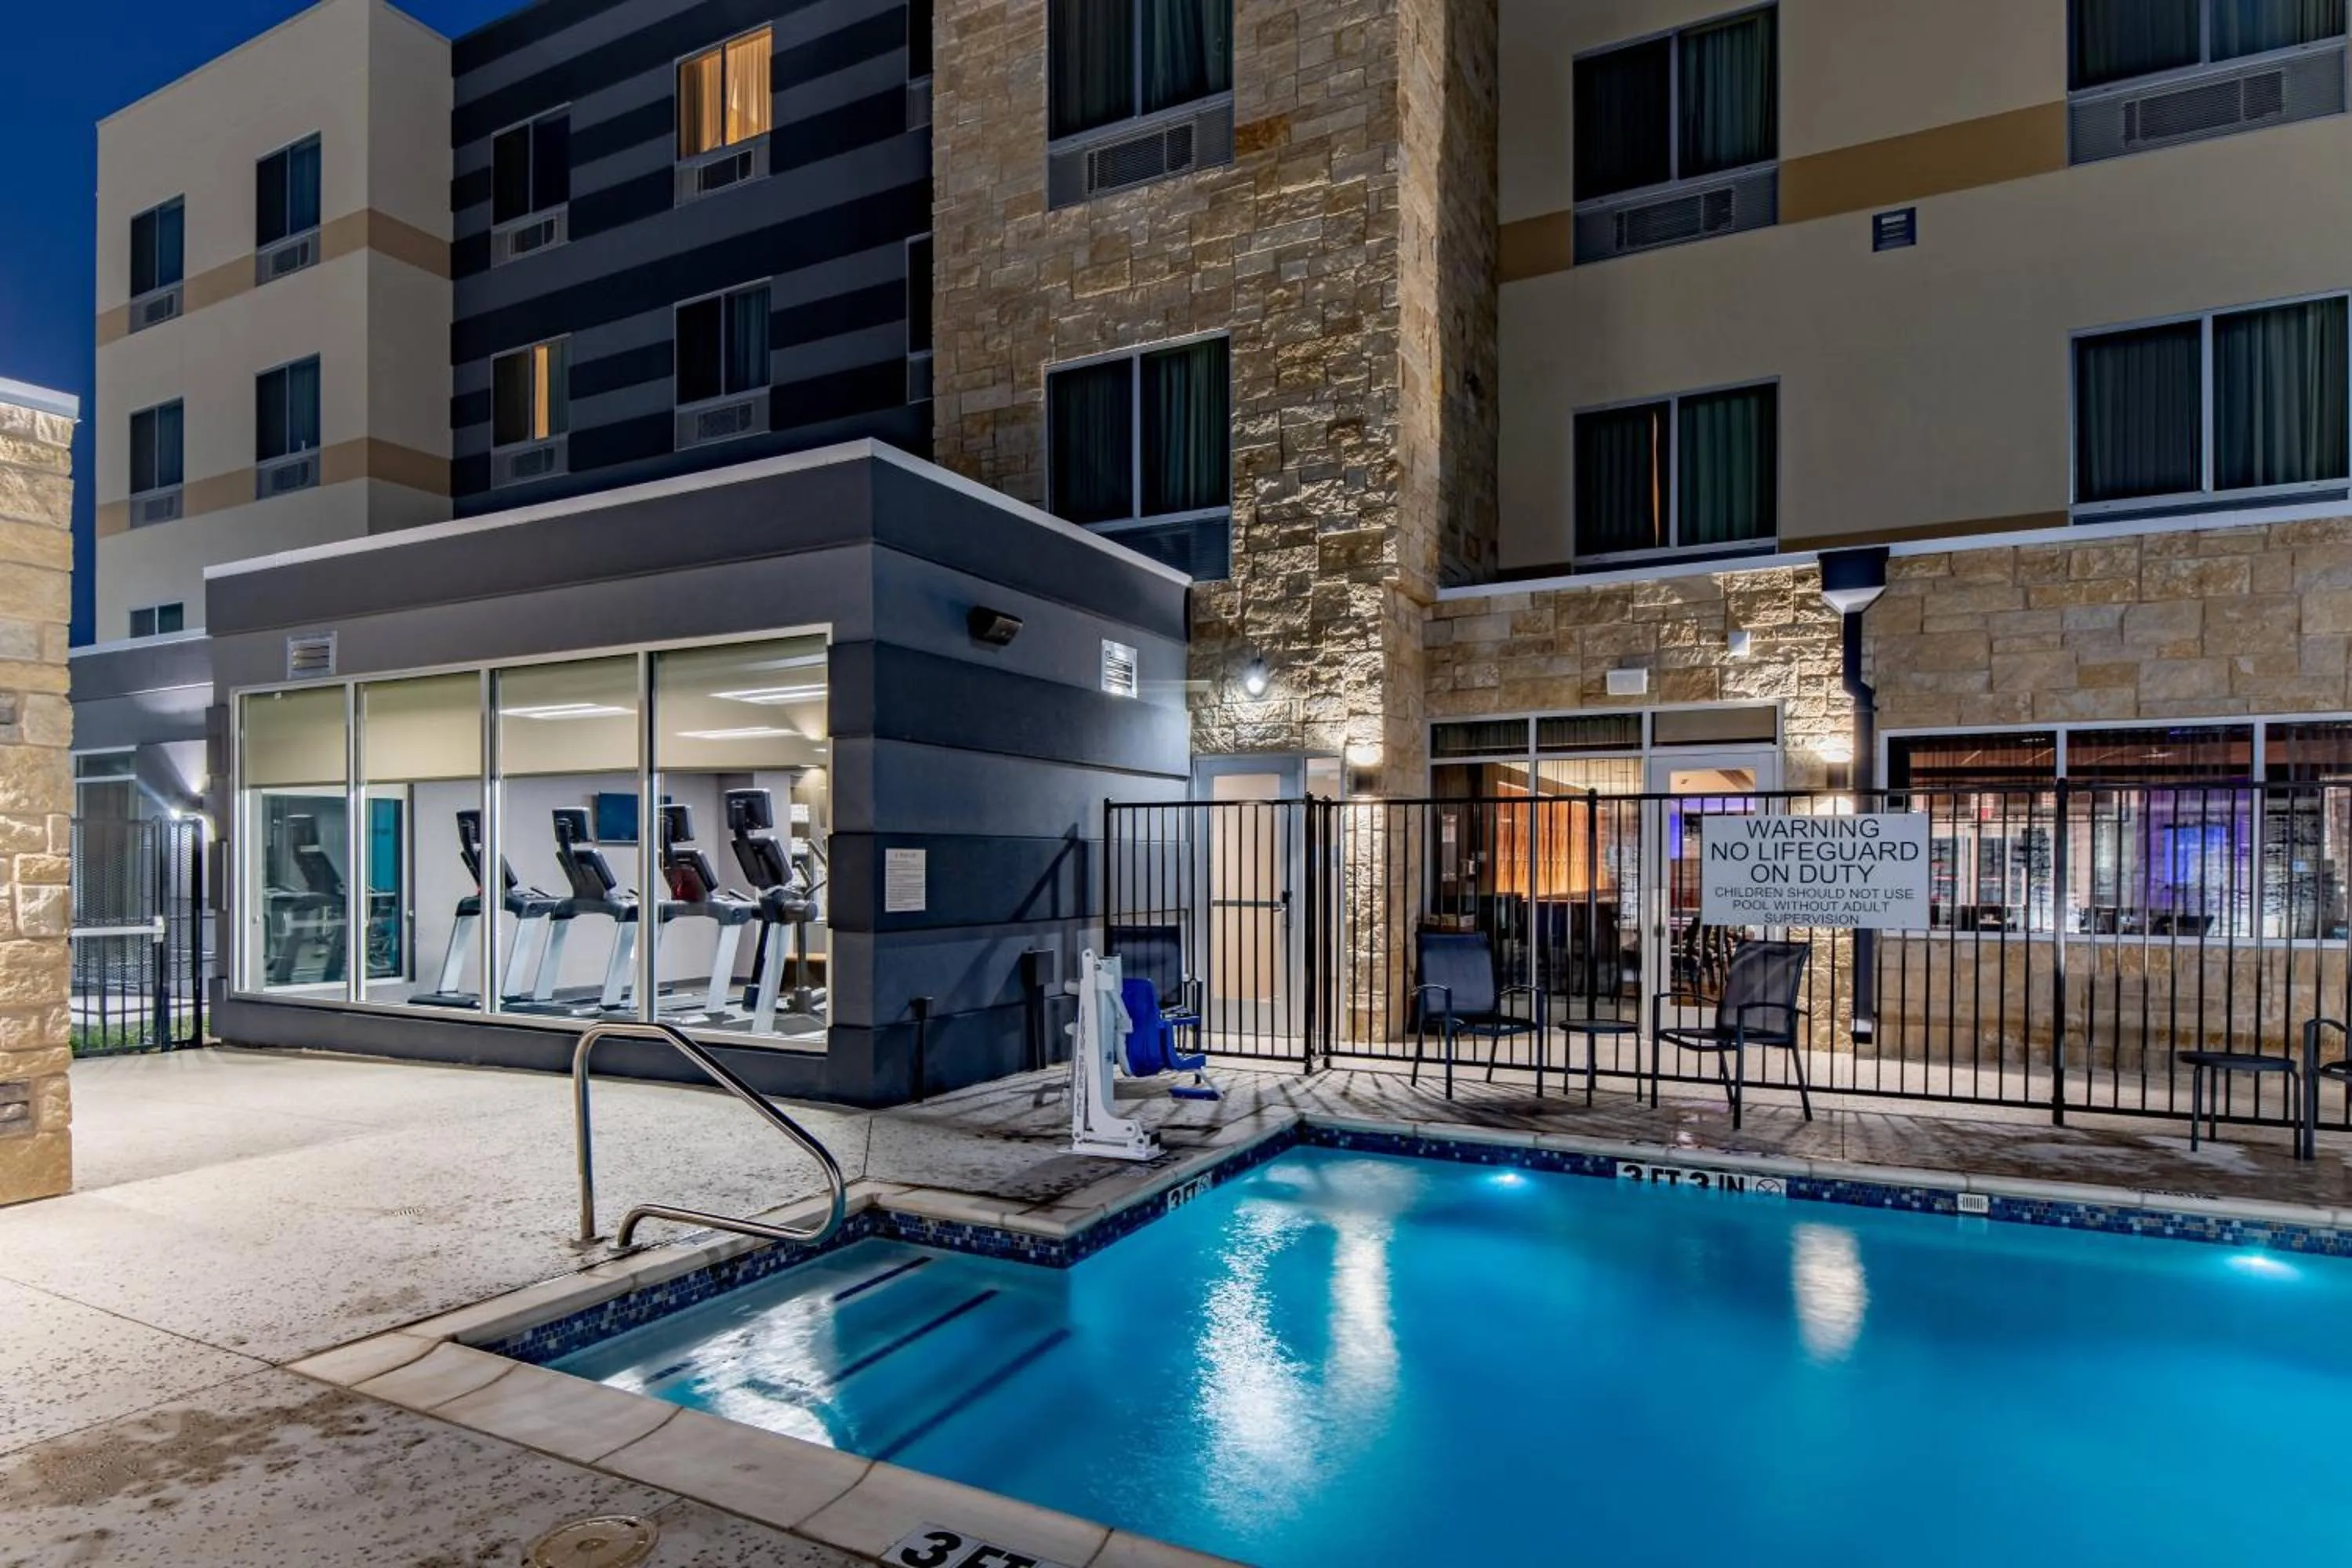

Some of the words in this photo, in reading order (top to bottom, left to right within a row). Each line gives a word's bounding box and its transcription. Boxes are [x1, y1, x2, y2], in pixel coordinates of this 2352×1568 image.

[1745, 818, 1879, 839] WARNING
[1711, 842, 1749, 861] NO
[1759, 841, 1918, 862] LIFEGUARD
[1751, 864, 1789, 884] ON
[1799, 865, 1875, 884] DUTY
[1715, 887, 1783, 898] CHILDREN
[1787, 887, 1844, 899] SHOULD
[1849, 888, 1880, 899] NOT
[1884, 888, 1914, 899] USE
[1732, 900, 1769, 910] POOL
[1774, 900, 1838, 911] WITHOUT
[1842, 902, 1889, 913] ADULT
[1764, 913, 1860, 924] SUPERVISION
[1651, 1167, 1681, 1185] FT
[1719, 1174, 1744, 1192] IN
[901, 1531, 961, 1567] 3
